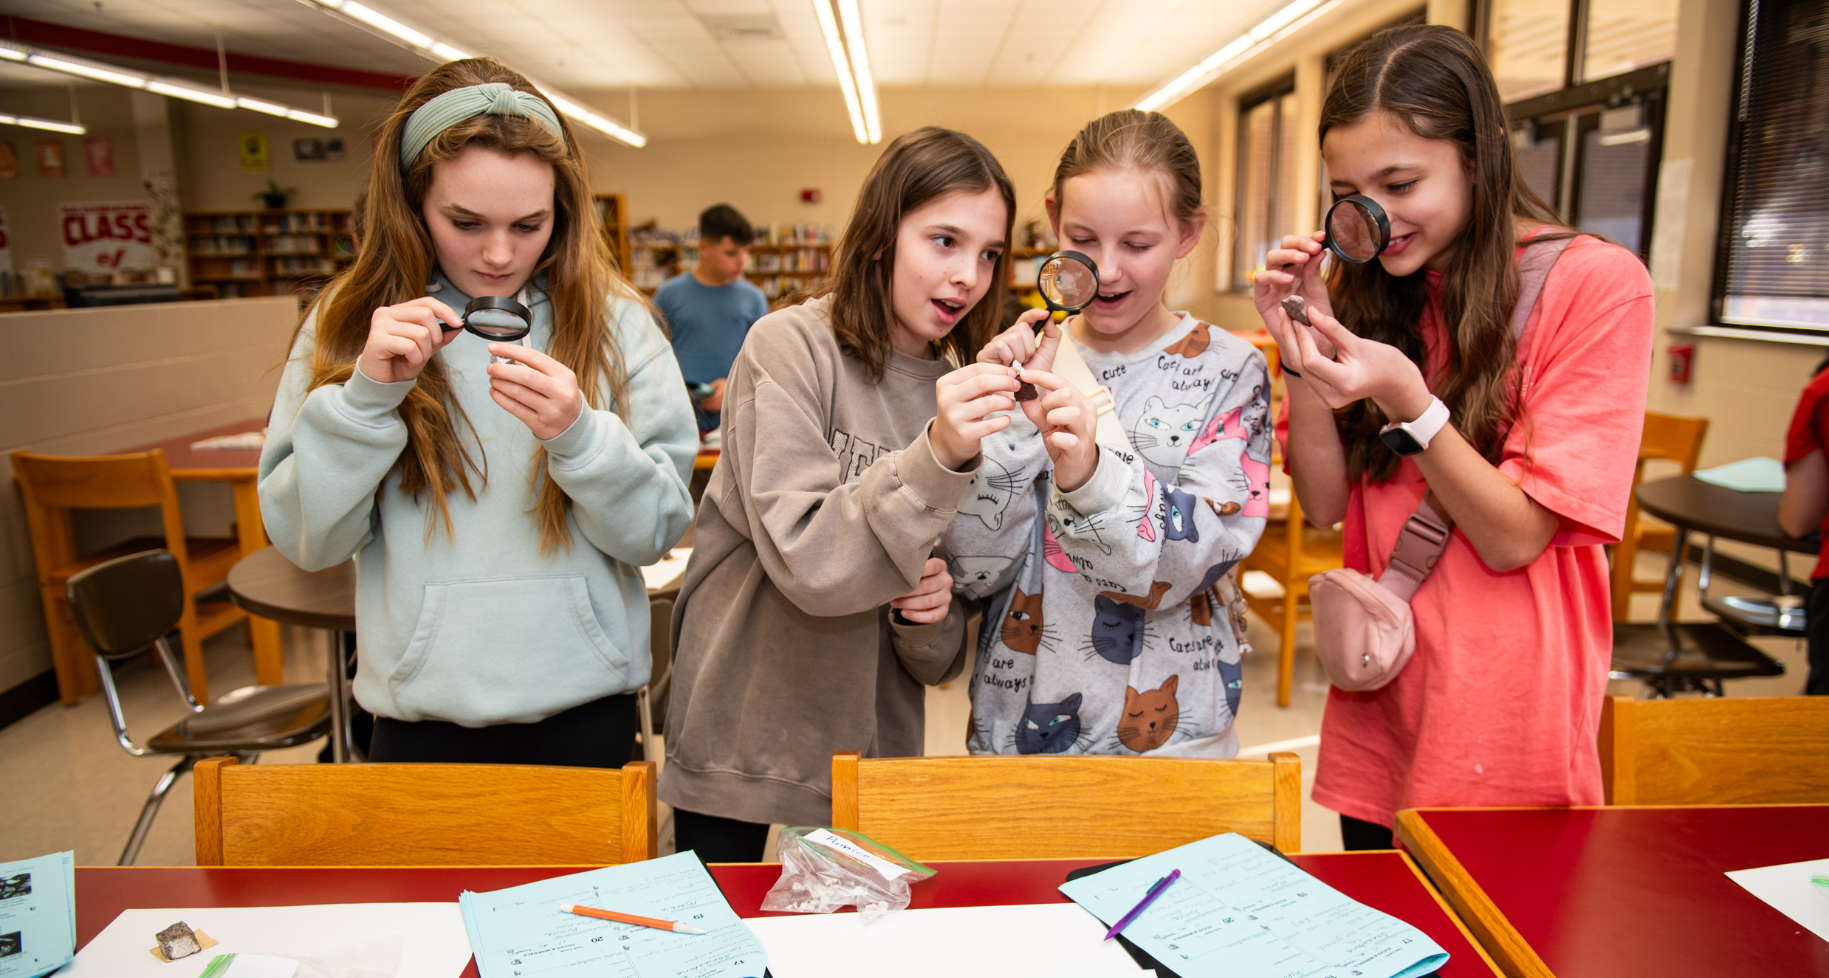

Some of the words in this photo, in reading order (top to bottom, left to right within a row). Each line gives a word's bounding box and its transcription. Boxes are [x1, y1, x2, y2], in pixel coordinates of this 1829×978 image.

[63, 215, 151, 246] CLASS
[1102, 364, 1127, 380] cute
[1169, 637, 1195, 653] Cats
[992, 658, 1014, 669] are
[983, 674, 1026, 692] always
[825, 834, 871, 859] Pumice
